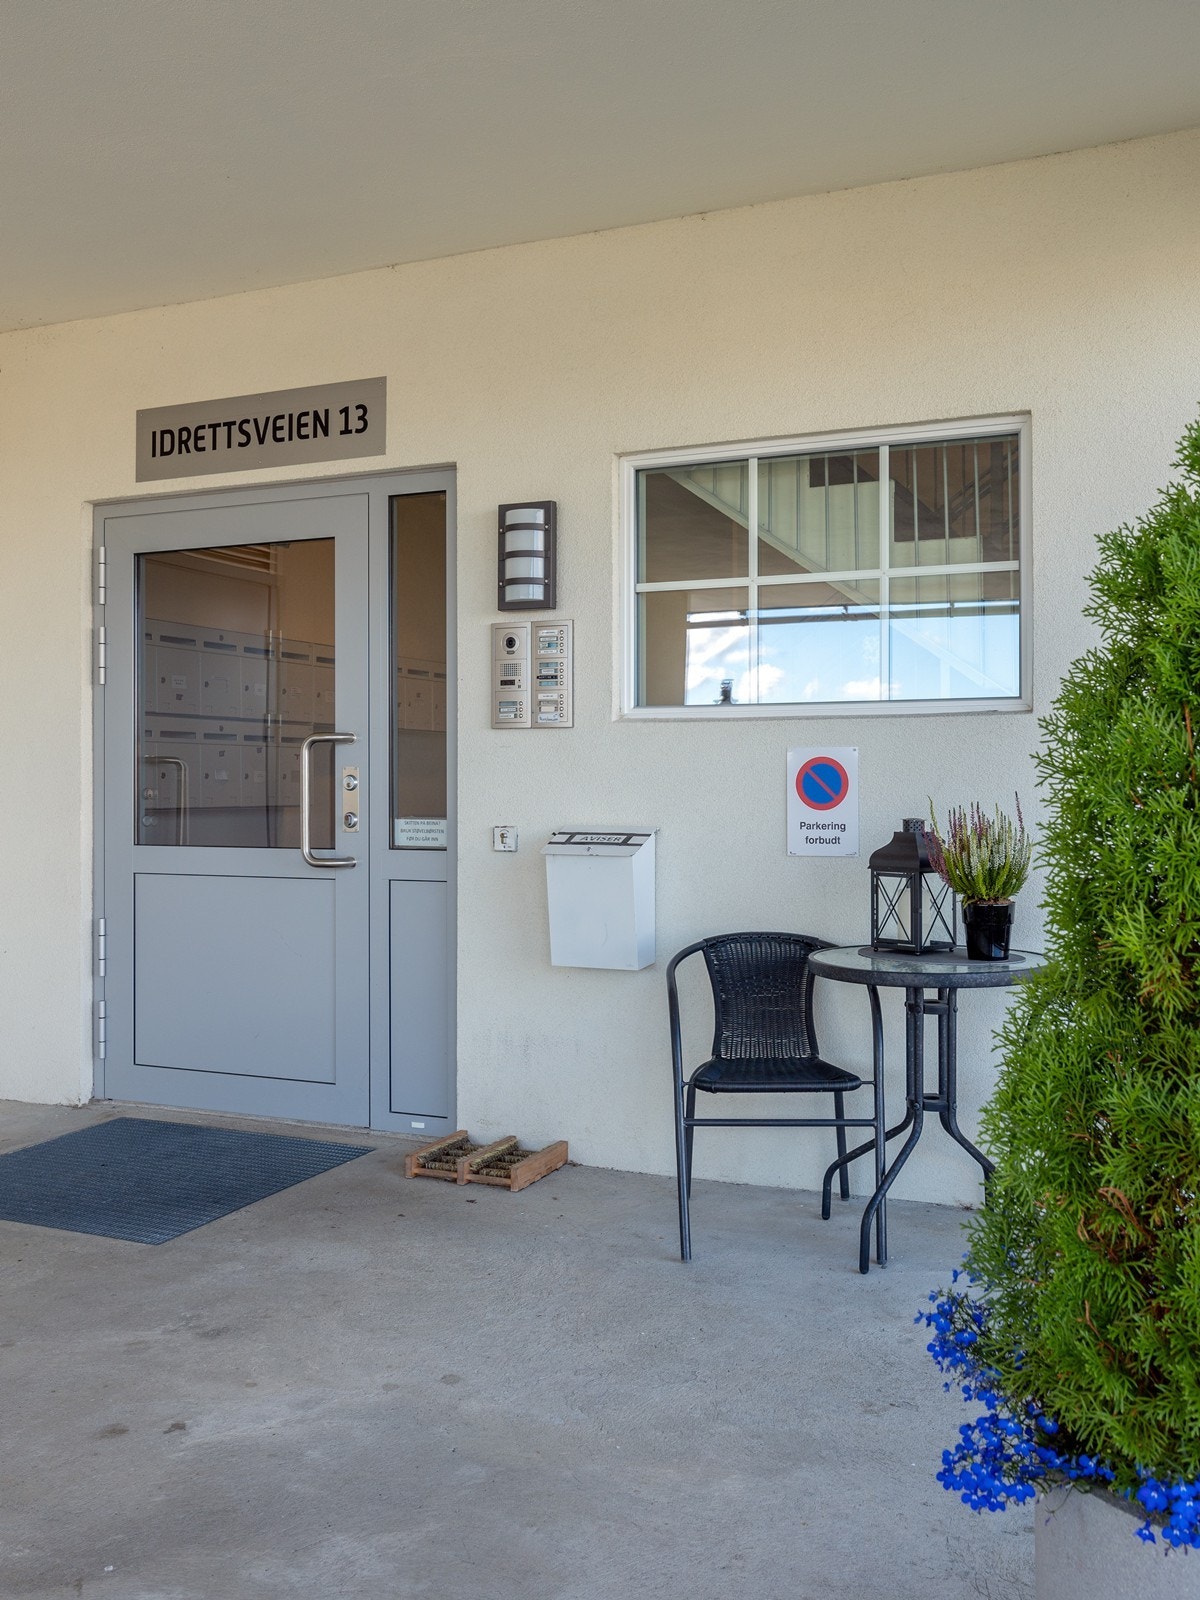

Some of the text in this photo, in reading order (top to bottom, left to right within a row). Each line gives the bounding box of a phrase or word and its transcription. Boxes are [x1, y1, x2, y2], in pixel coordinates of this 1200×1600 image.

[151, 403, 369, 458] IDRETTSVEIEN 13
[799, 821, 846, 832] Parkering
[805, 836, 841, 845] forbudt
